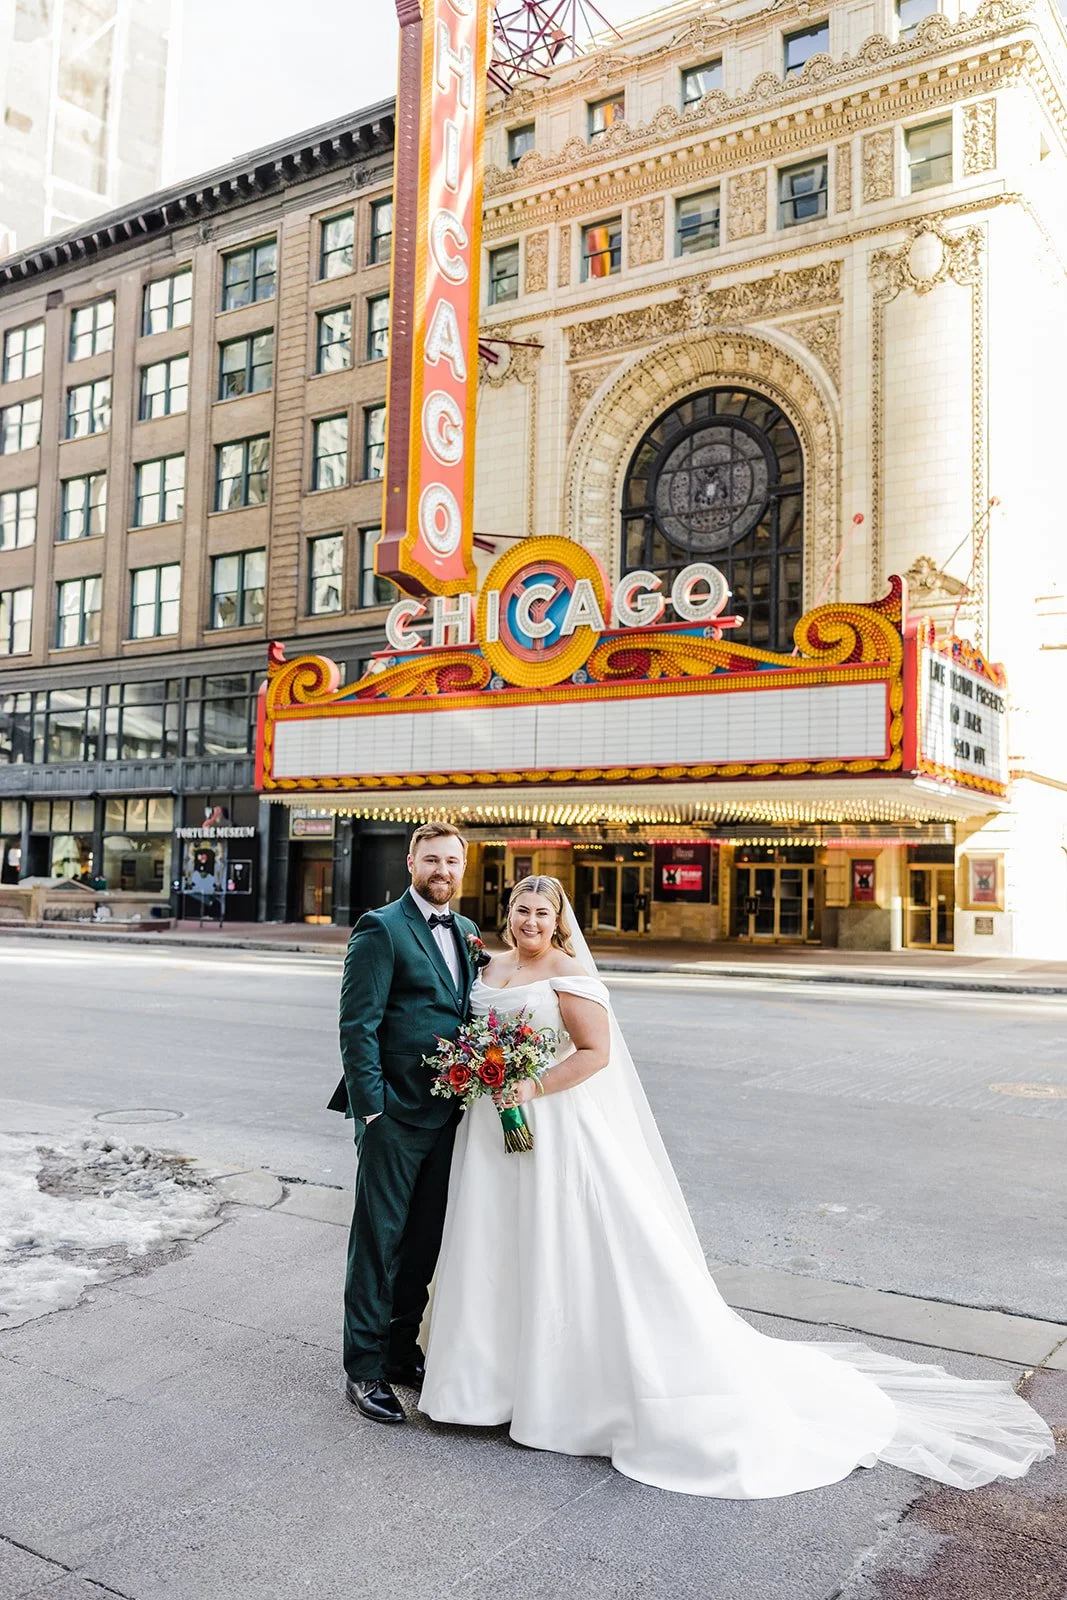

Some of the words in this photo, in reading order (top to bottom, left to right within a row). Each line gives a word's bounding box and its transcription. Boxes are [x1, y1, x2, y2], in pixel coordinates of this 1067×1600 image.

[417, 0, 474, 559] HICAGO
[385, 562, 728, 650] CHICAGO
[175, 827, 215, 839] TORTURE
[216, 826, 255, 838] MUSEUM
